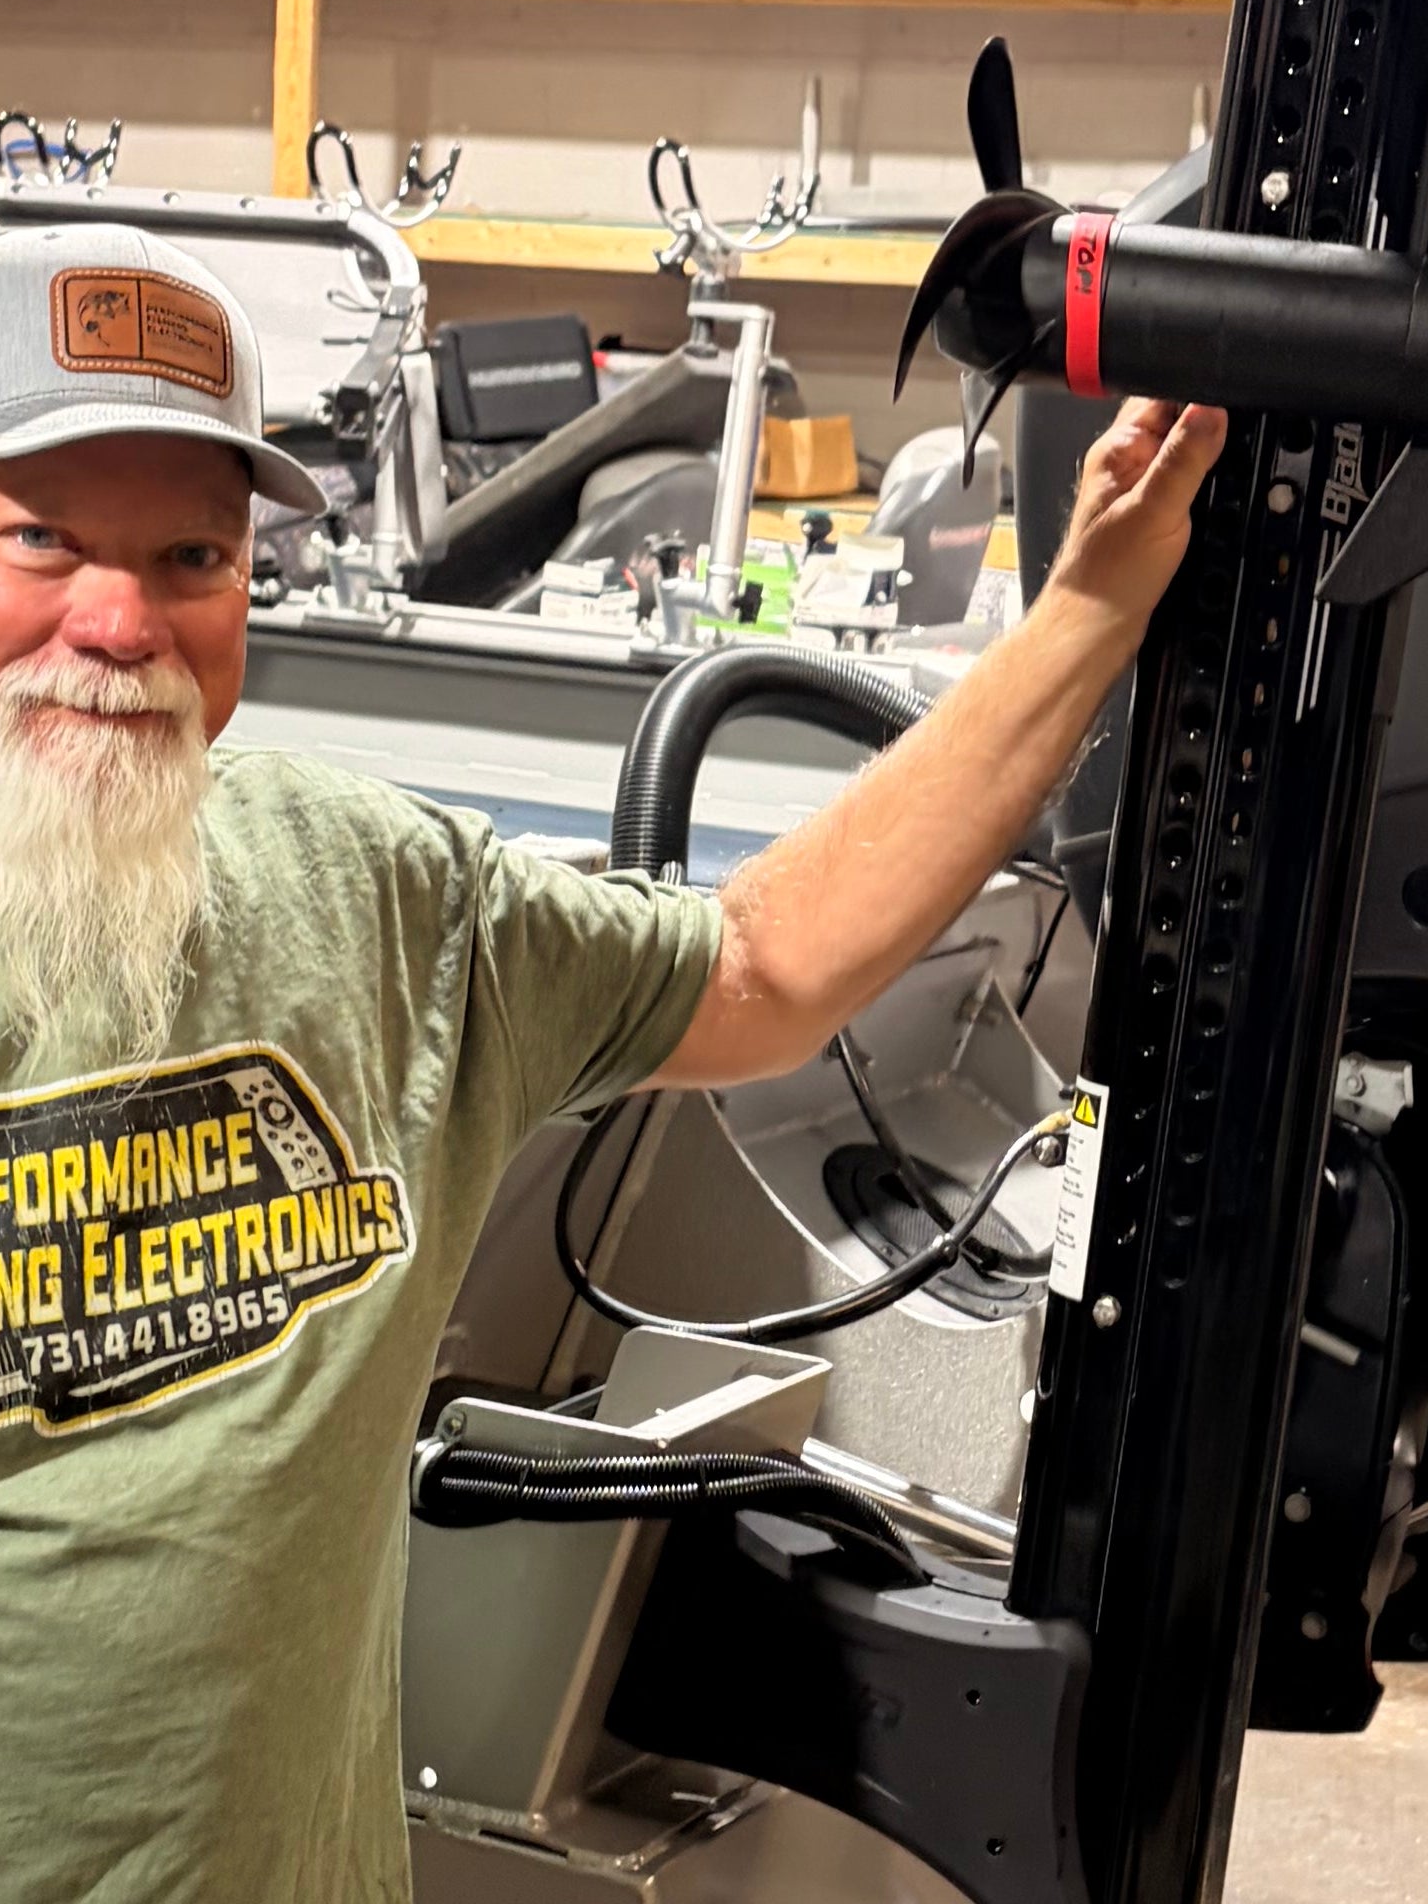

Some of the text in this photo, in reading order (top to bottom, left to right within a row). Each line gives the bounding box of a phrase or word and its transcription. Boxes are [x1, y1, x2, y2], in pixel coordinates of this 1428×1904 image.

[1320, 422, 1370, 526] Blad
[84, 1178, 403, 1317] ELECTRONICS
[22, 1285, 289, 1377] 731.441.8965
